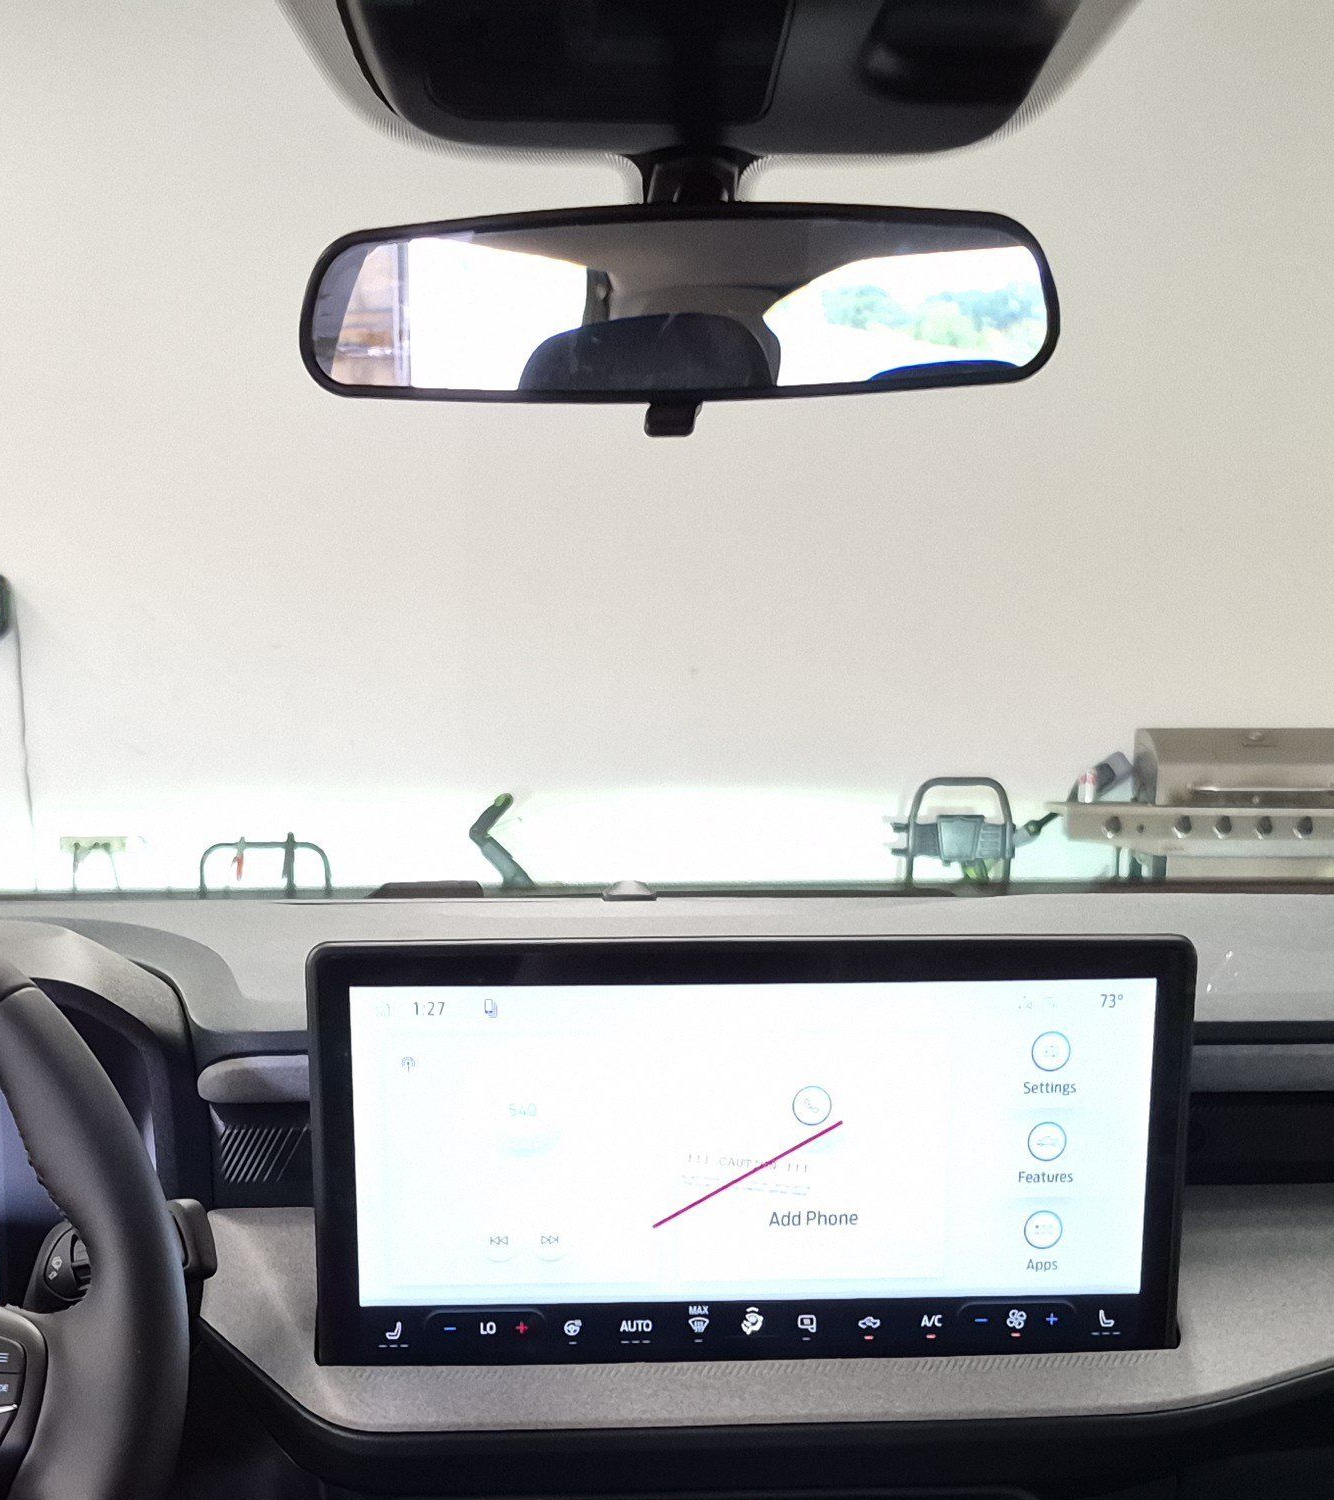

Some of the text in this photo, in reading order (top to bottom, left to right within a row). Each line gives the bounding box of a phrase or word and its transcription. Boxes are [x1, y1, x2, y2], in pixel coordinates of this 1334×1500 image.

[413, 1001, 445, 1016] 1:27
[1023, 1081, 1077, 1096] Settings
[719, 1156, 777, 1171] CAUTN
[1018, 1170, 1074, 1183] Features
[769, 1210, 859, 1227] Add Phone
[1026, 1258, 1058, 1272] Apps
[688, 1305, 709, 1315] MAX
[620, 1319, 653, 1332] AUTO
[920, 1314, 942, 1327] A/C
[480, 1321, 497, 1335] LO
